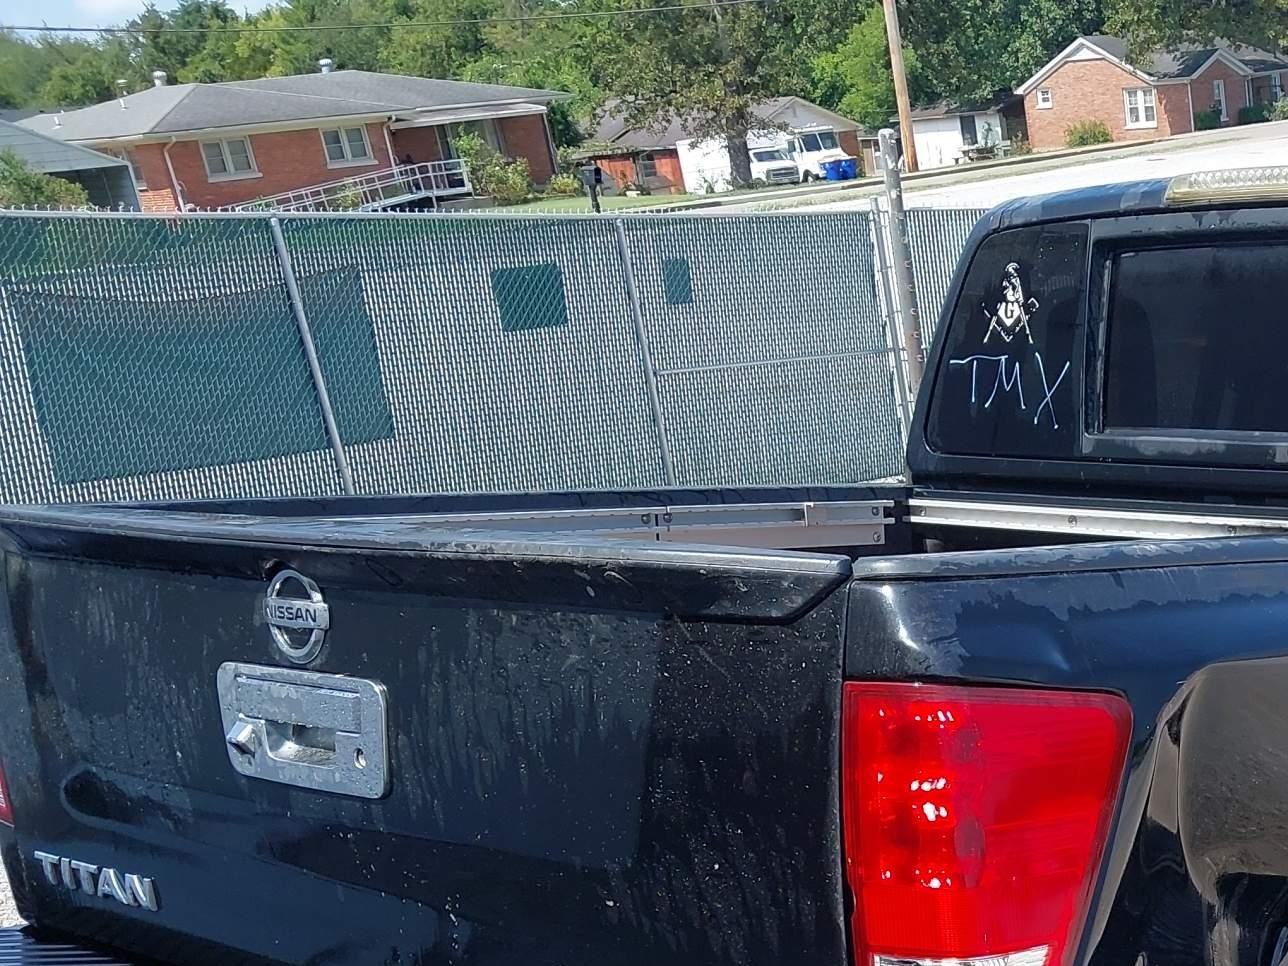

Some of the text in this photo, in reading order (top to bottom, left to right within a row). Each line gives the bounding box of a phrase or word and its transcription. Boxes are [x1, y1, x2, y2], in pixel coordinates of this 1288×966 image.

[950, 351, 1070, 430] TMX
[266, 604, 318, 623] NISSAN
[34, 850, 159, 912] TITAN
